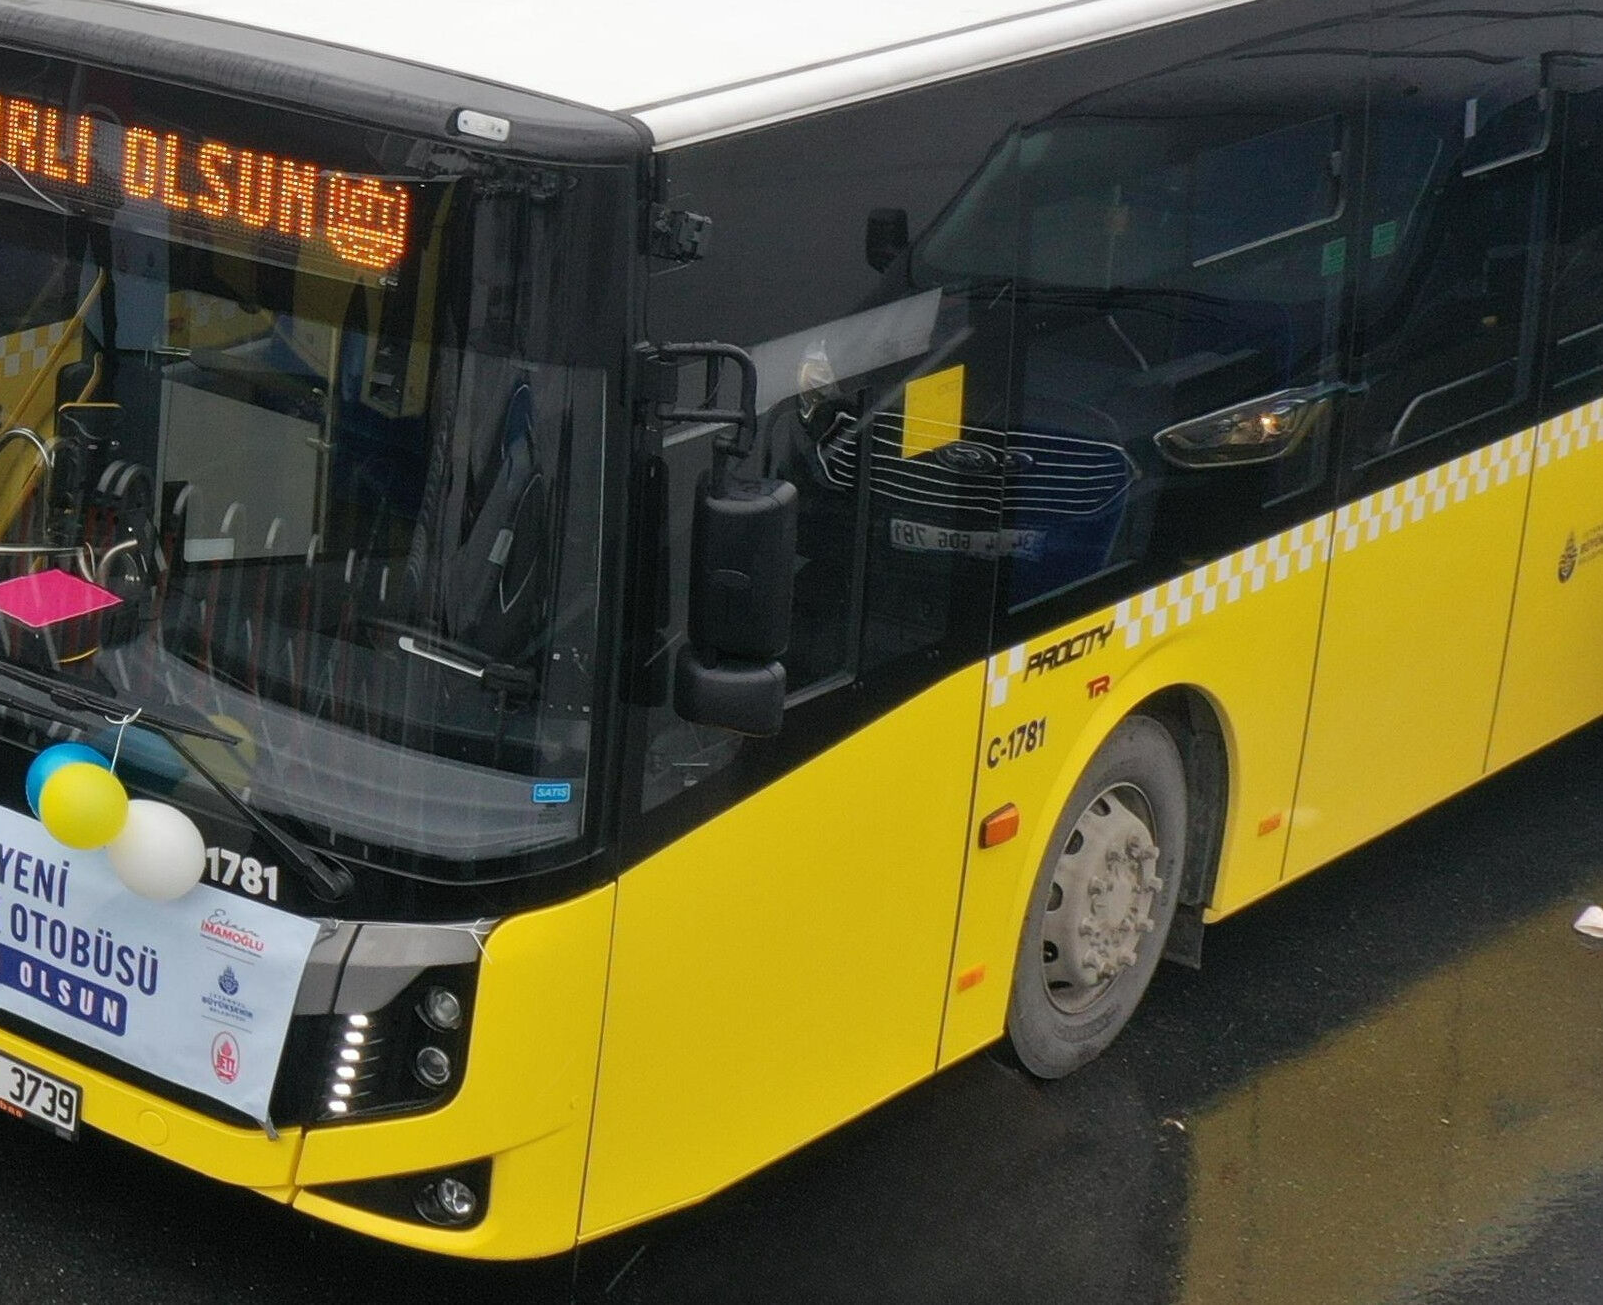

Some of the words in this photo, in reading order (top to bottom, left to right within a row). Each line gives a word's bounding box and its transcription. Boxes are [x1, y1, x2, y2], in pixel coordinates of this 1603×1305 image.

[122, 125, 319, 239] OLSUN
[1023, 620, 1116, 683] PROCITY
[1086, 674, 1111, 699] TR
[986, 716, 1047, 769] C-1781
[205, 846, 278, 902] 1781
[9, 902, 159, 996] OTOBÜSÜ
[19, 960, 120, 1028] OLSUN
[9, 1066, 74, 1125] 3739
